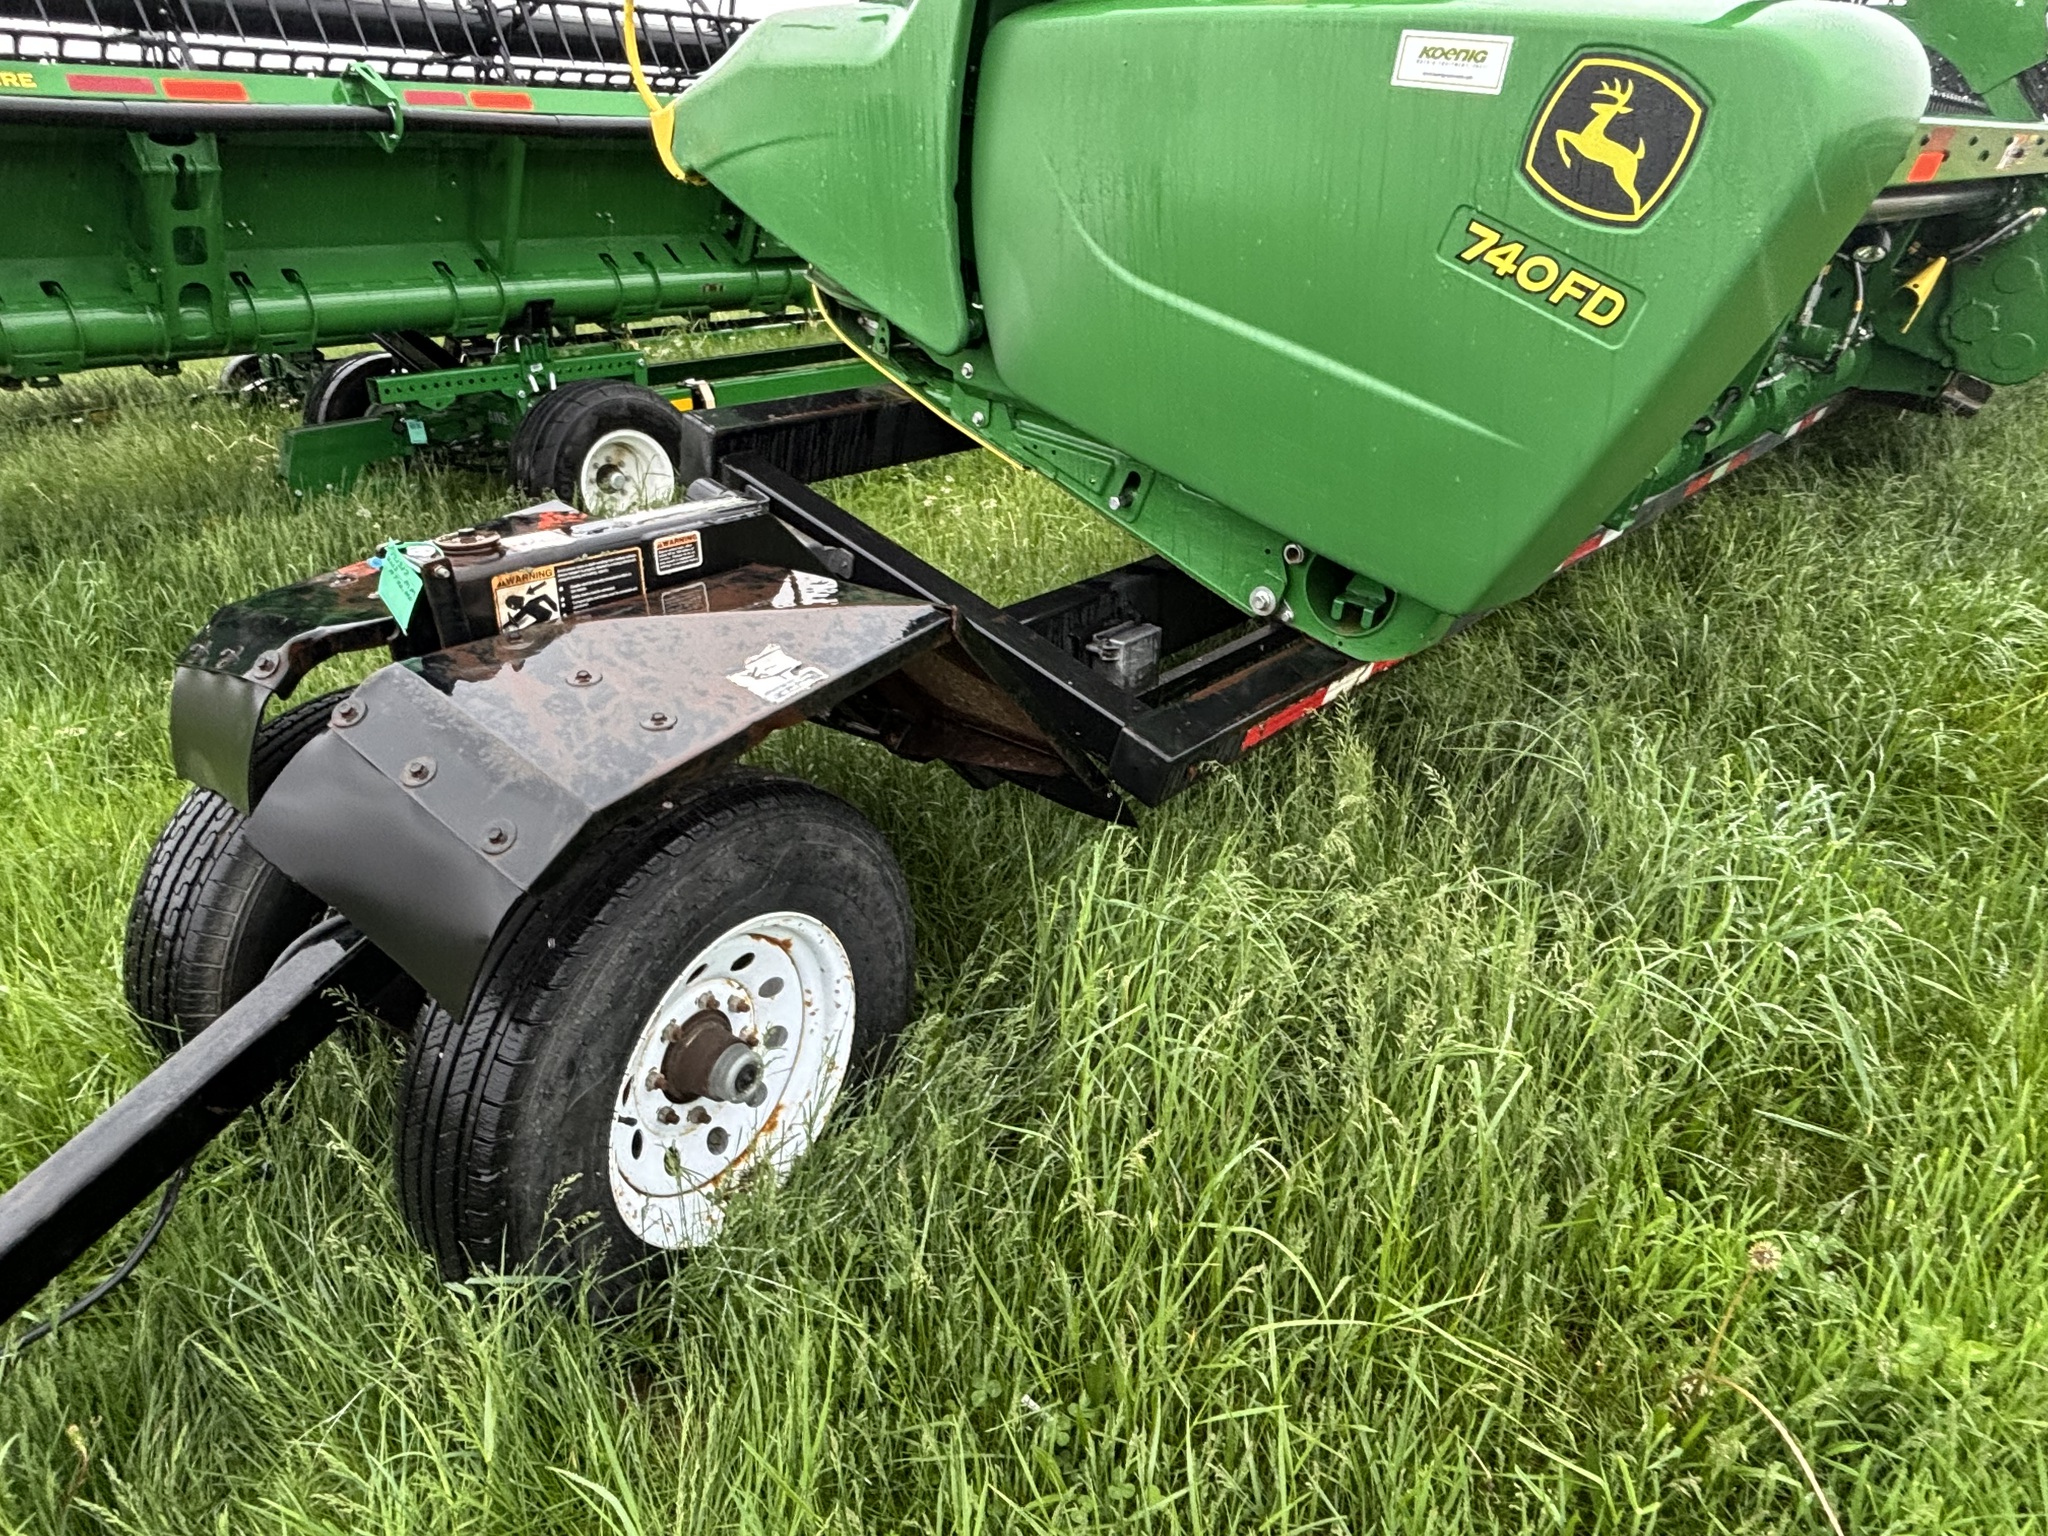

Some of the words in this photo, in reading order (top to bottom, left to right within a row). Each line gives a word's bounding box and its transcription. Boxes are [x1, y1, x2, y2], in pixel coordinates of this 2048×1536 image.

[0, 72, 38, 88] RE
[1456, 219, 1627, 328] 740FD
[505, 568, 553, 586] WARNING
